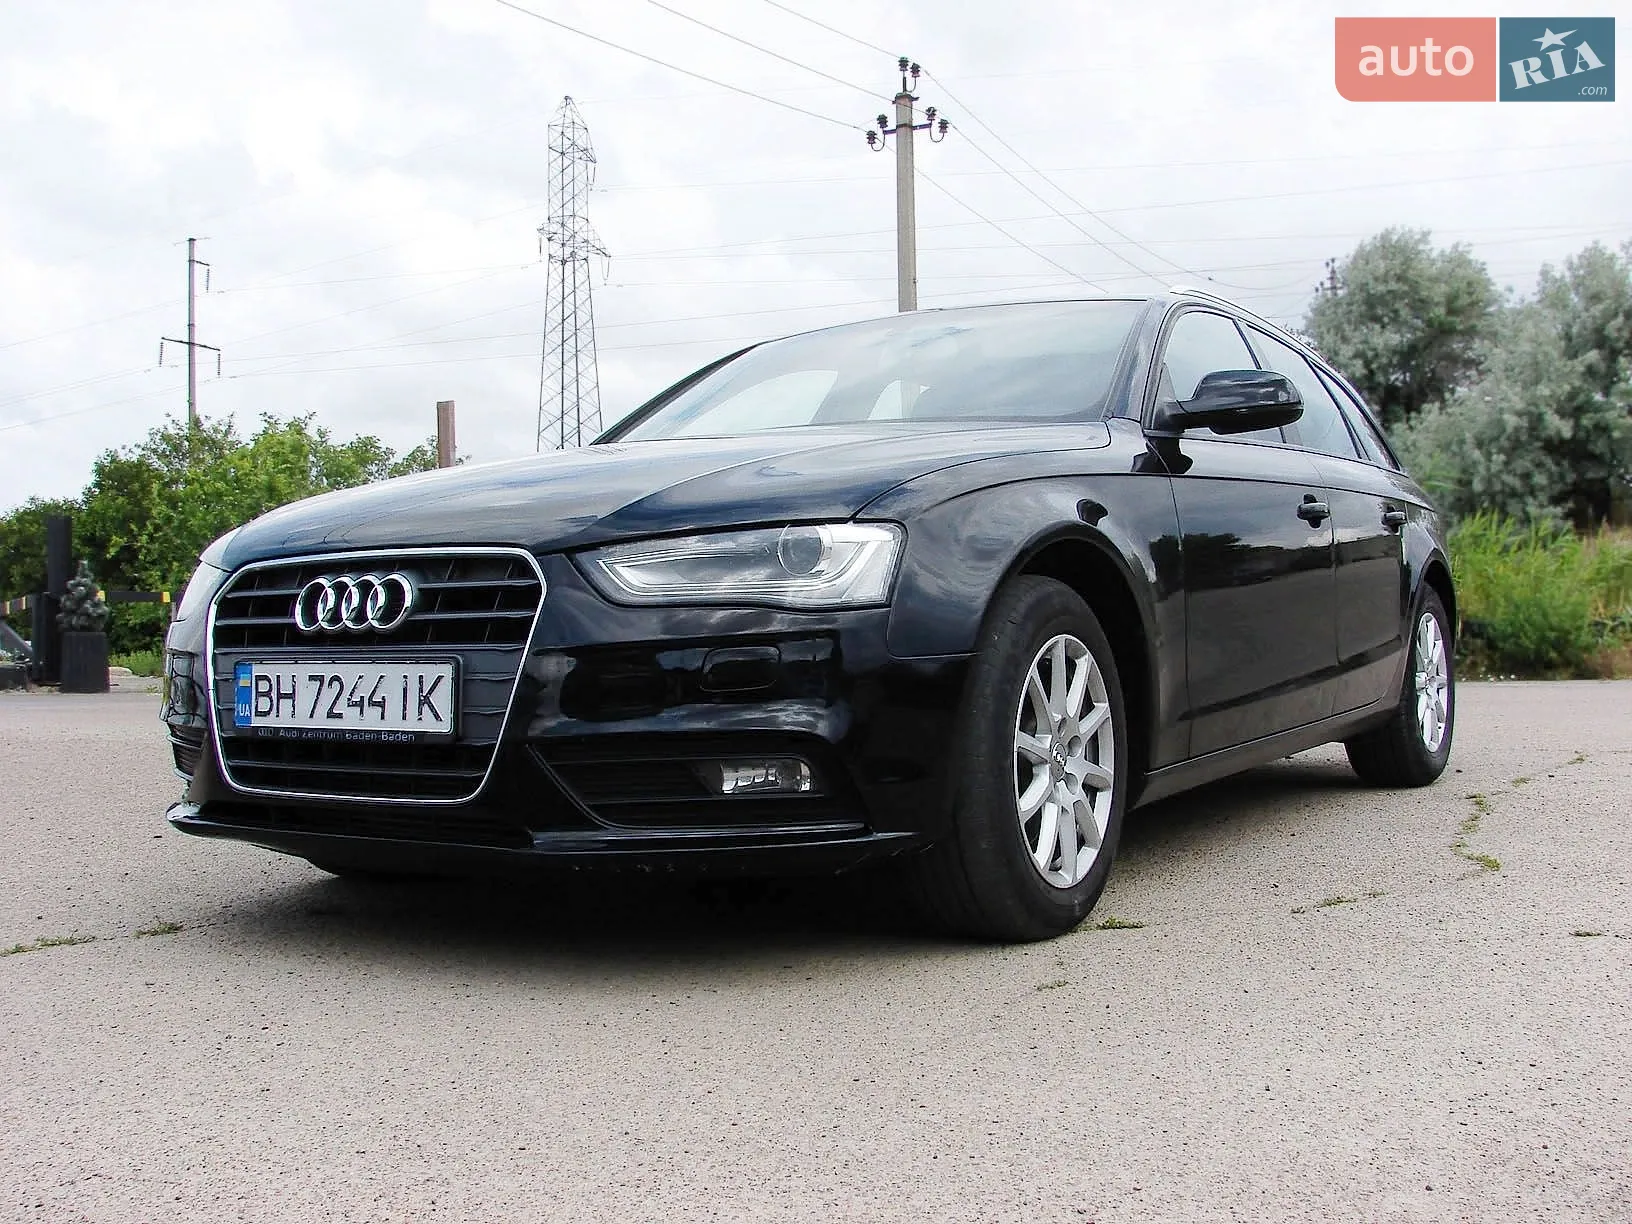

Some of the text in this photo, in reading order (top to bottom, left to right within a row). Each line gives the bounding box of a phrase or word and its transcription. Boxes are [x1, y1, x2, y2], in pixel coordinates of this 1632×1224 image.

[254, 674, 445, 722] BH 7244 IK
[239, 703, 251, 717] UA
[279, 729, 300, 738] Audi
